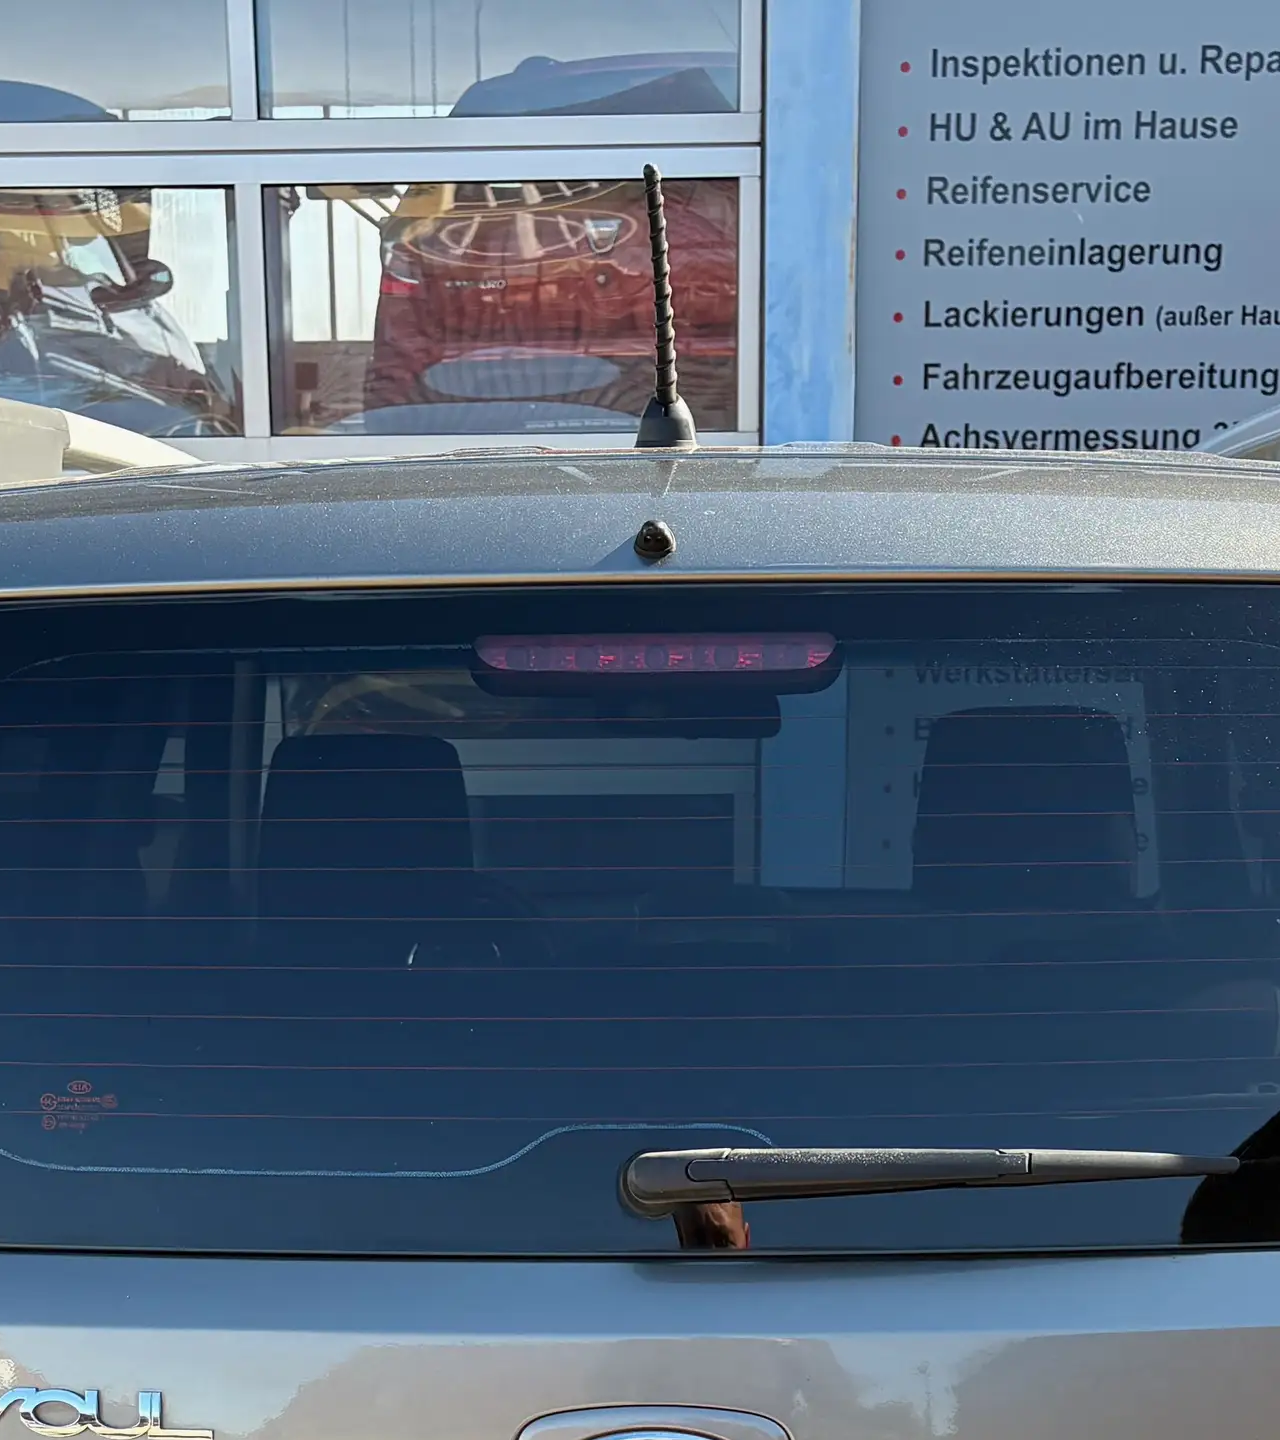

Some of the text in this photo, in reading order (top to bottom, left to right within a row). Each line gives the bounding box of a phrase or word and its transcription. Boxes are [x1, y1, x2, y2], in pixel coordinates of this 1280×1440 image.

[931, 47, 1146, 86] Inspektionen
[1158, 53, 1187, 76] u.
[930, 109, 1239, 142] HU & AU im Hause
[926, 174, 1151, 205] Reifenservice
[923, 237, 1223, 273] Reifeneinlagerung
[923, 299, 1145, 334] Lackierungen
[1155, 304, 1234, 332] (außer
[922, 361, 1280, 397] Fahrzeugaufbereitung
